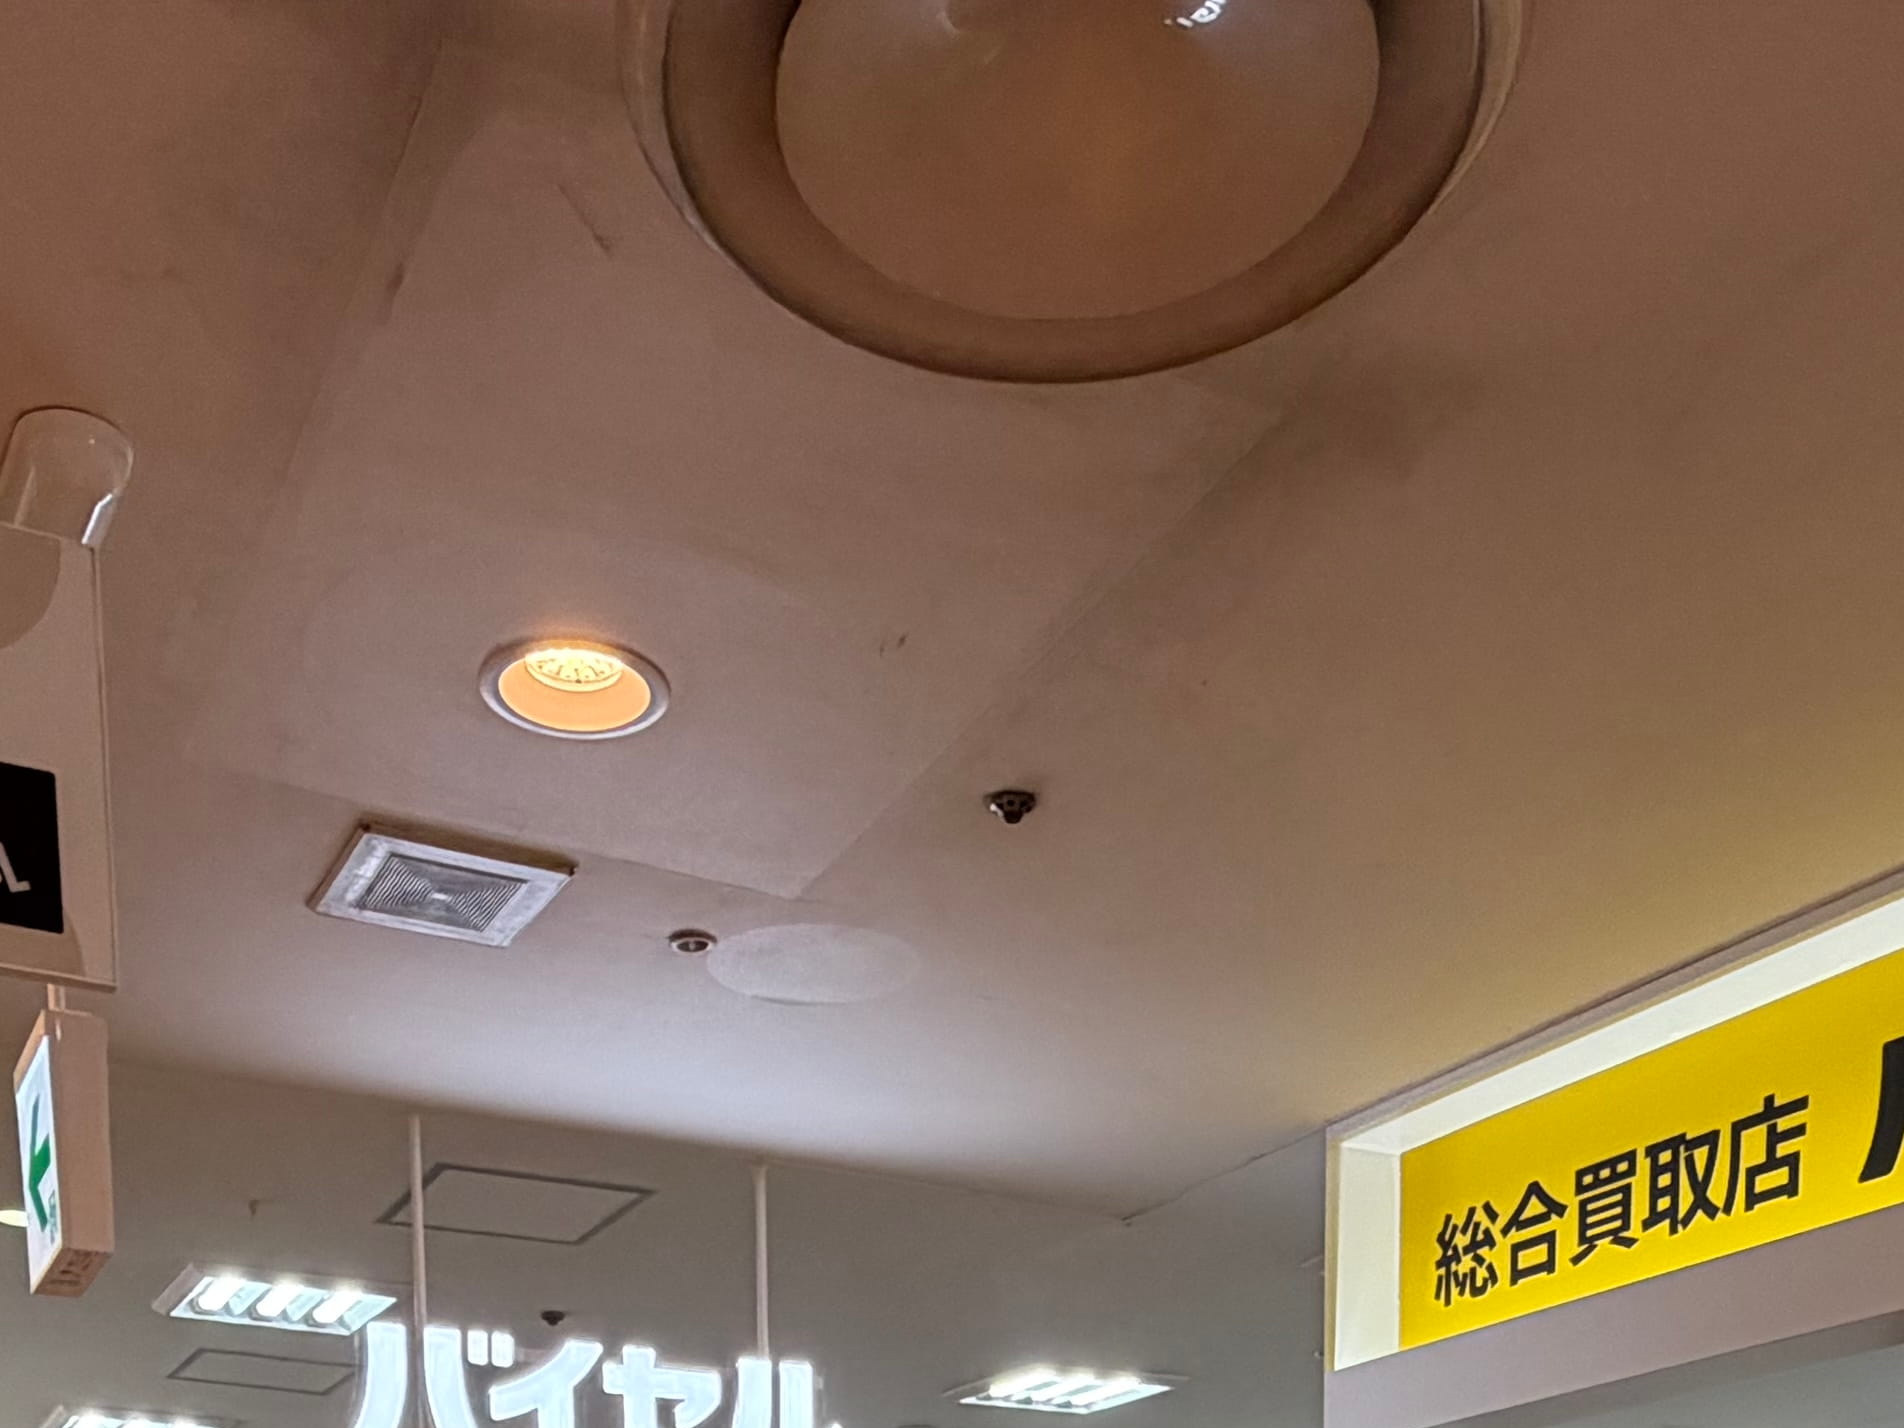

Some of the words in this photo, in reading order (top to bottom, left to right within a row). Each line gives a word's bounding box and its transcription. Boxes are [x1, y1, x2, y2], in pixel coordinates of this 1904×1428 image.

[1433, 1093, 1809, 1308] 総合買取店
